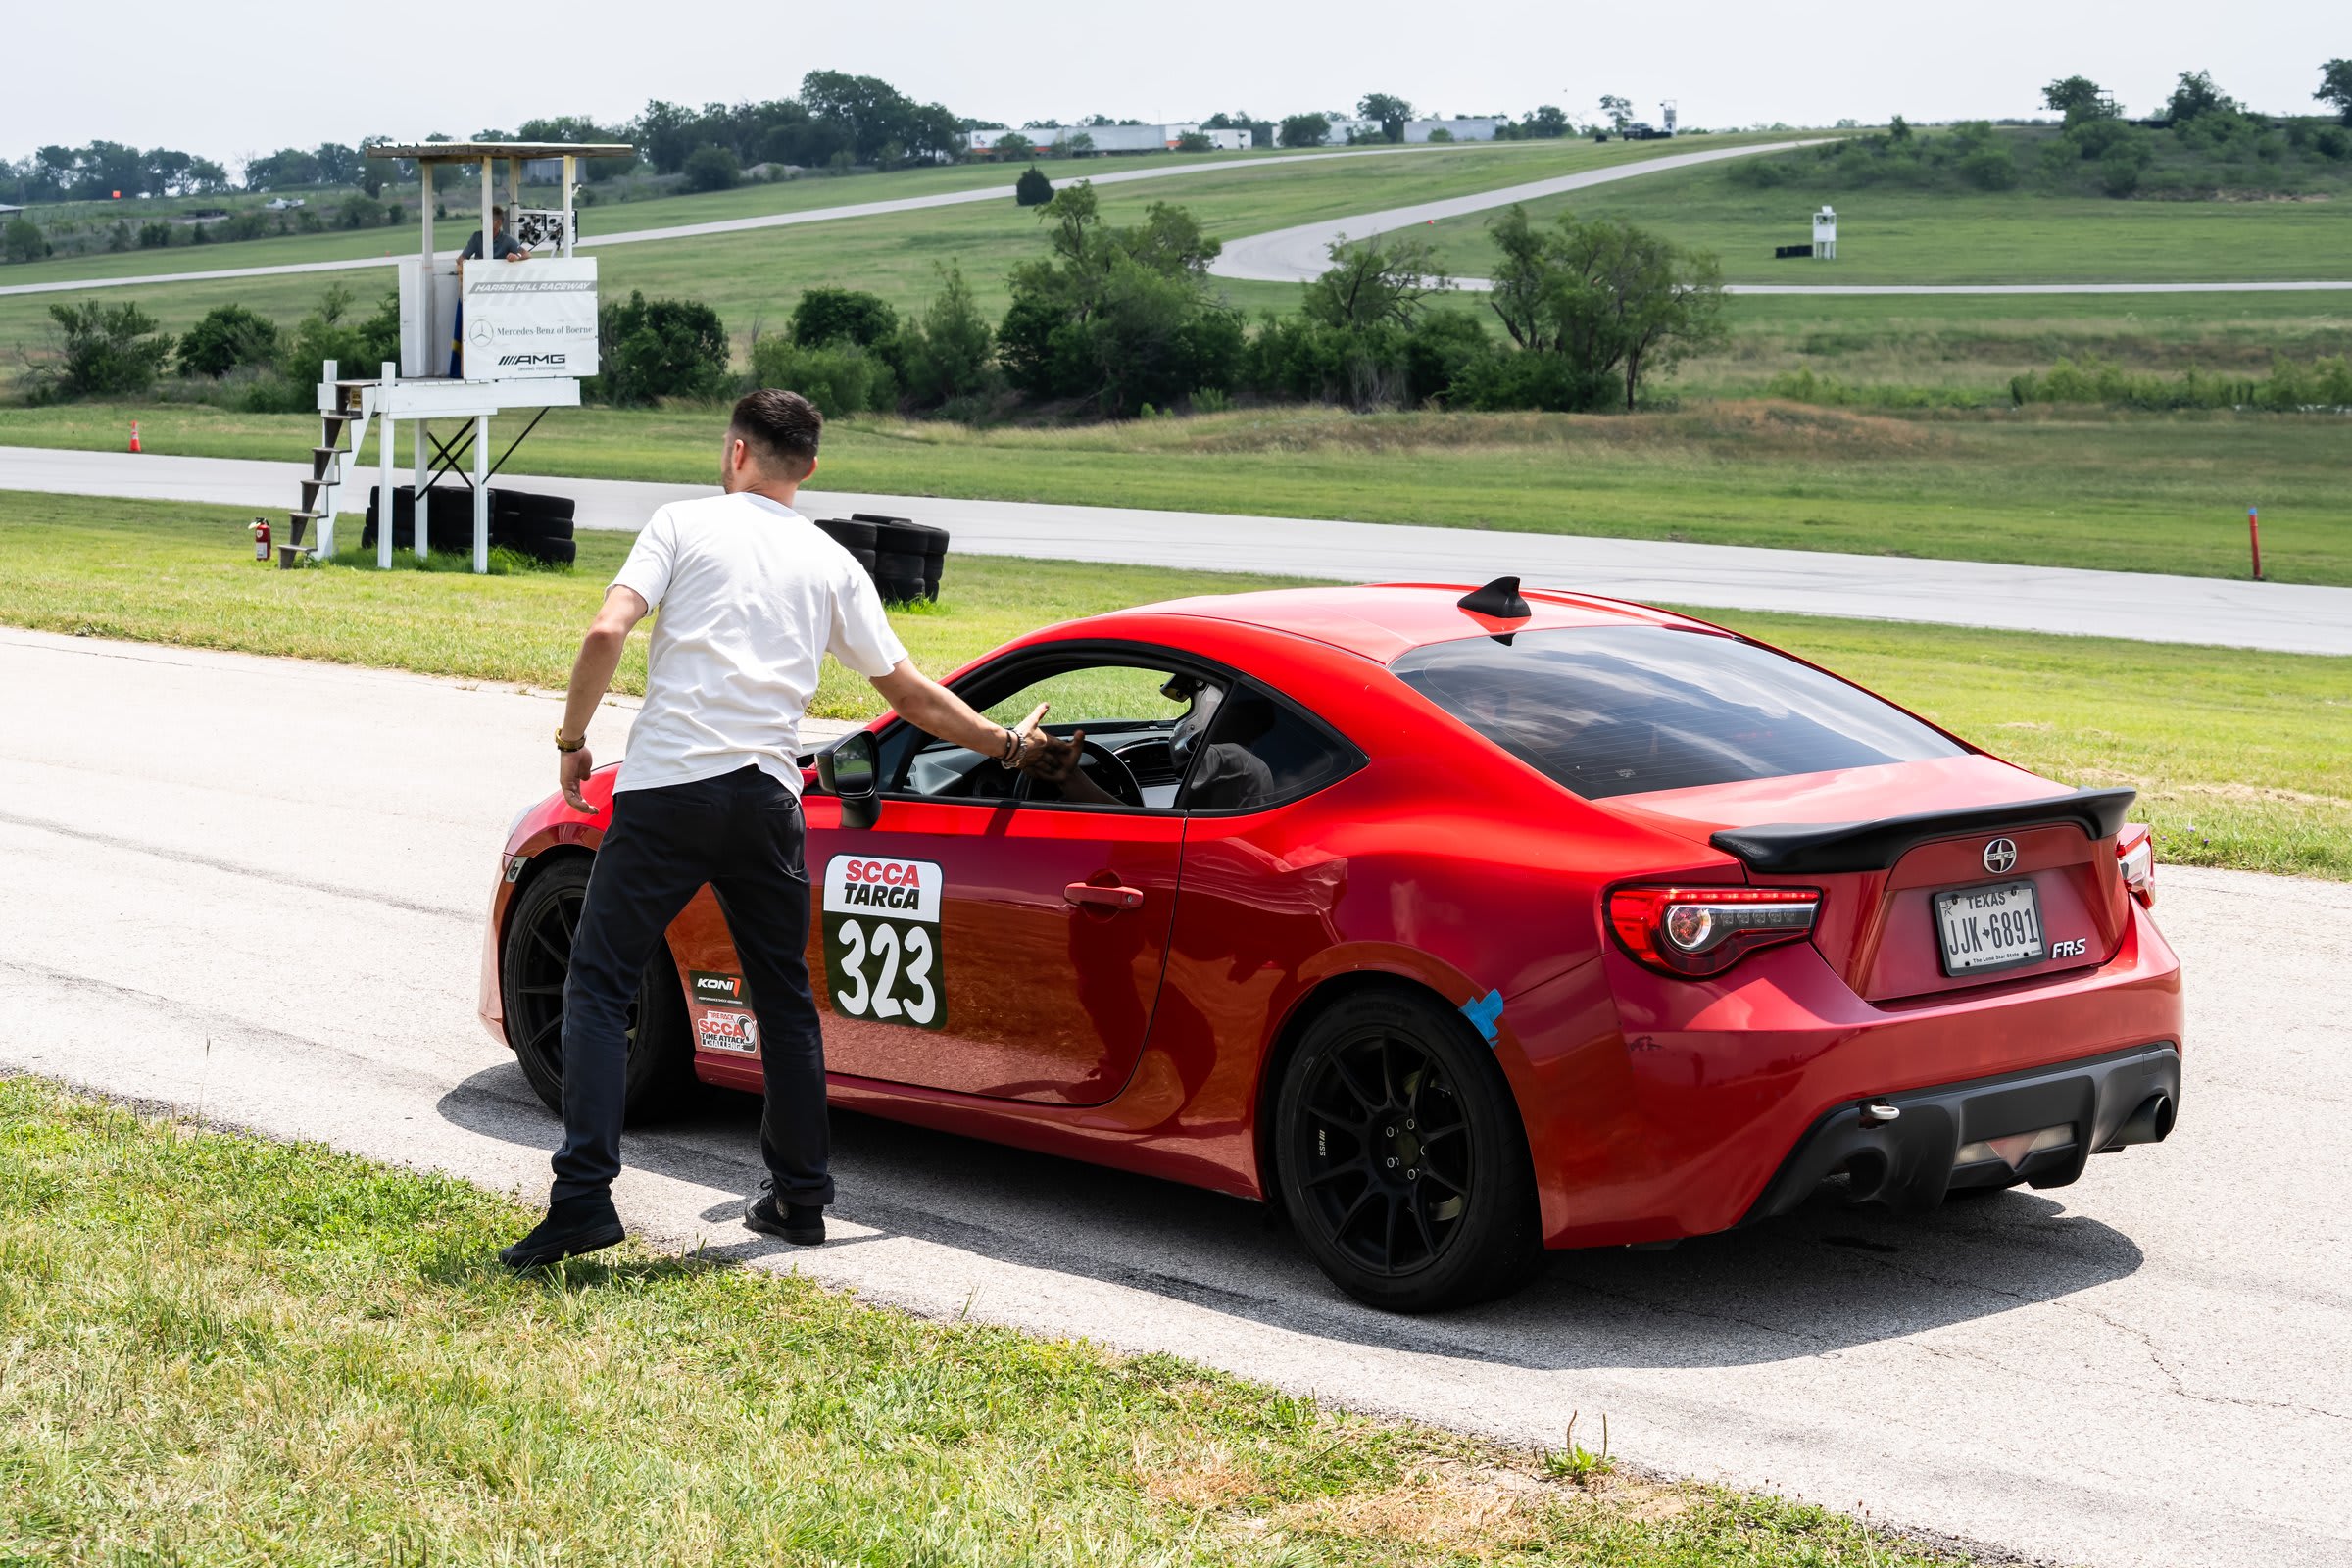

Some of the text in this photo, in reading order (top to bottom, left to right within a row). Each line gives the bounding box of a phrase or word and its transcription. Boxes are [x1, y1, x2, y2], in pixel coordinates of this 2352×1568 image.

[474, 283, 516, 292] HARRIS
[538, 282, 592, 291] RACEWAY
[557, 325, 564, 334] of
[565, 325, 593, 334] Boerne
[845, 859, 920, 888] SCCA
[844, 883, 920, 910] TARGA
[1966, 892, 2006, 909] TEXAS
[837, 918, 936, 1024] 323
[697, 978, 734, 991] KONI
[699, 1020, 745, 1038] SCCA
[706, 1039, 744, 1050] CHALLENGE
[719, 1035, 745, 1045] ATTACK
